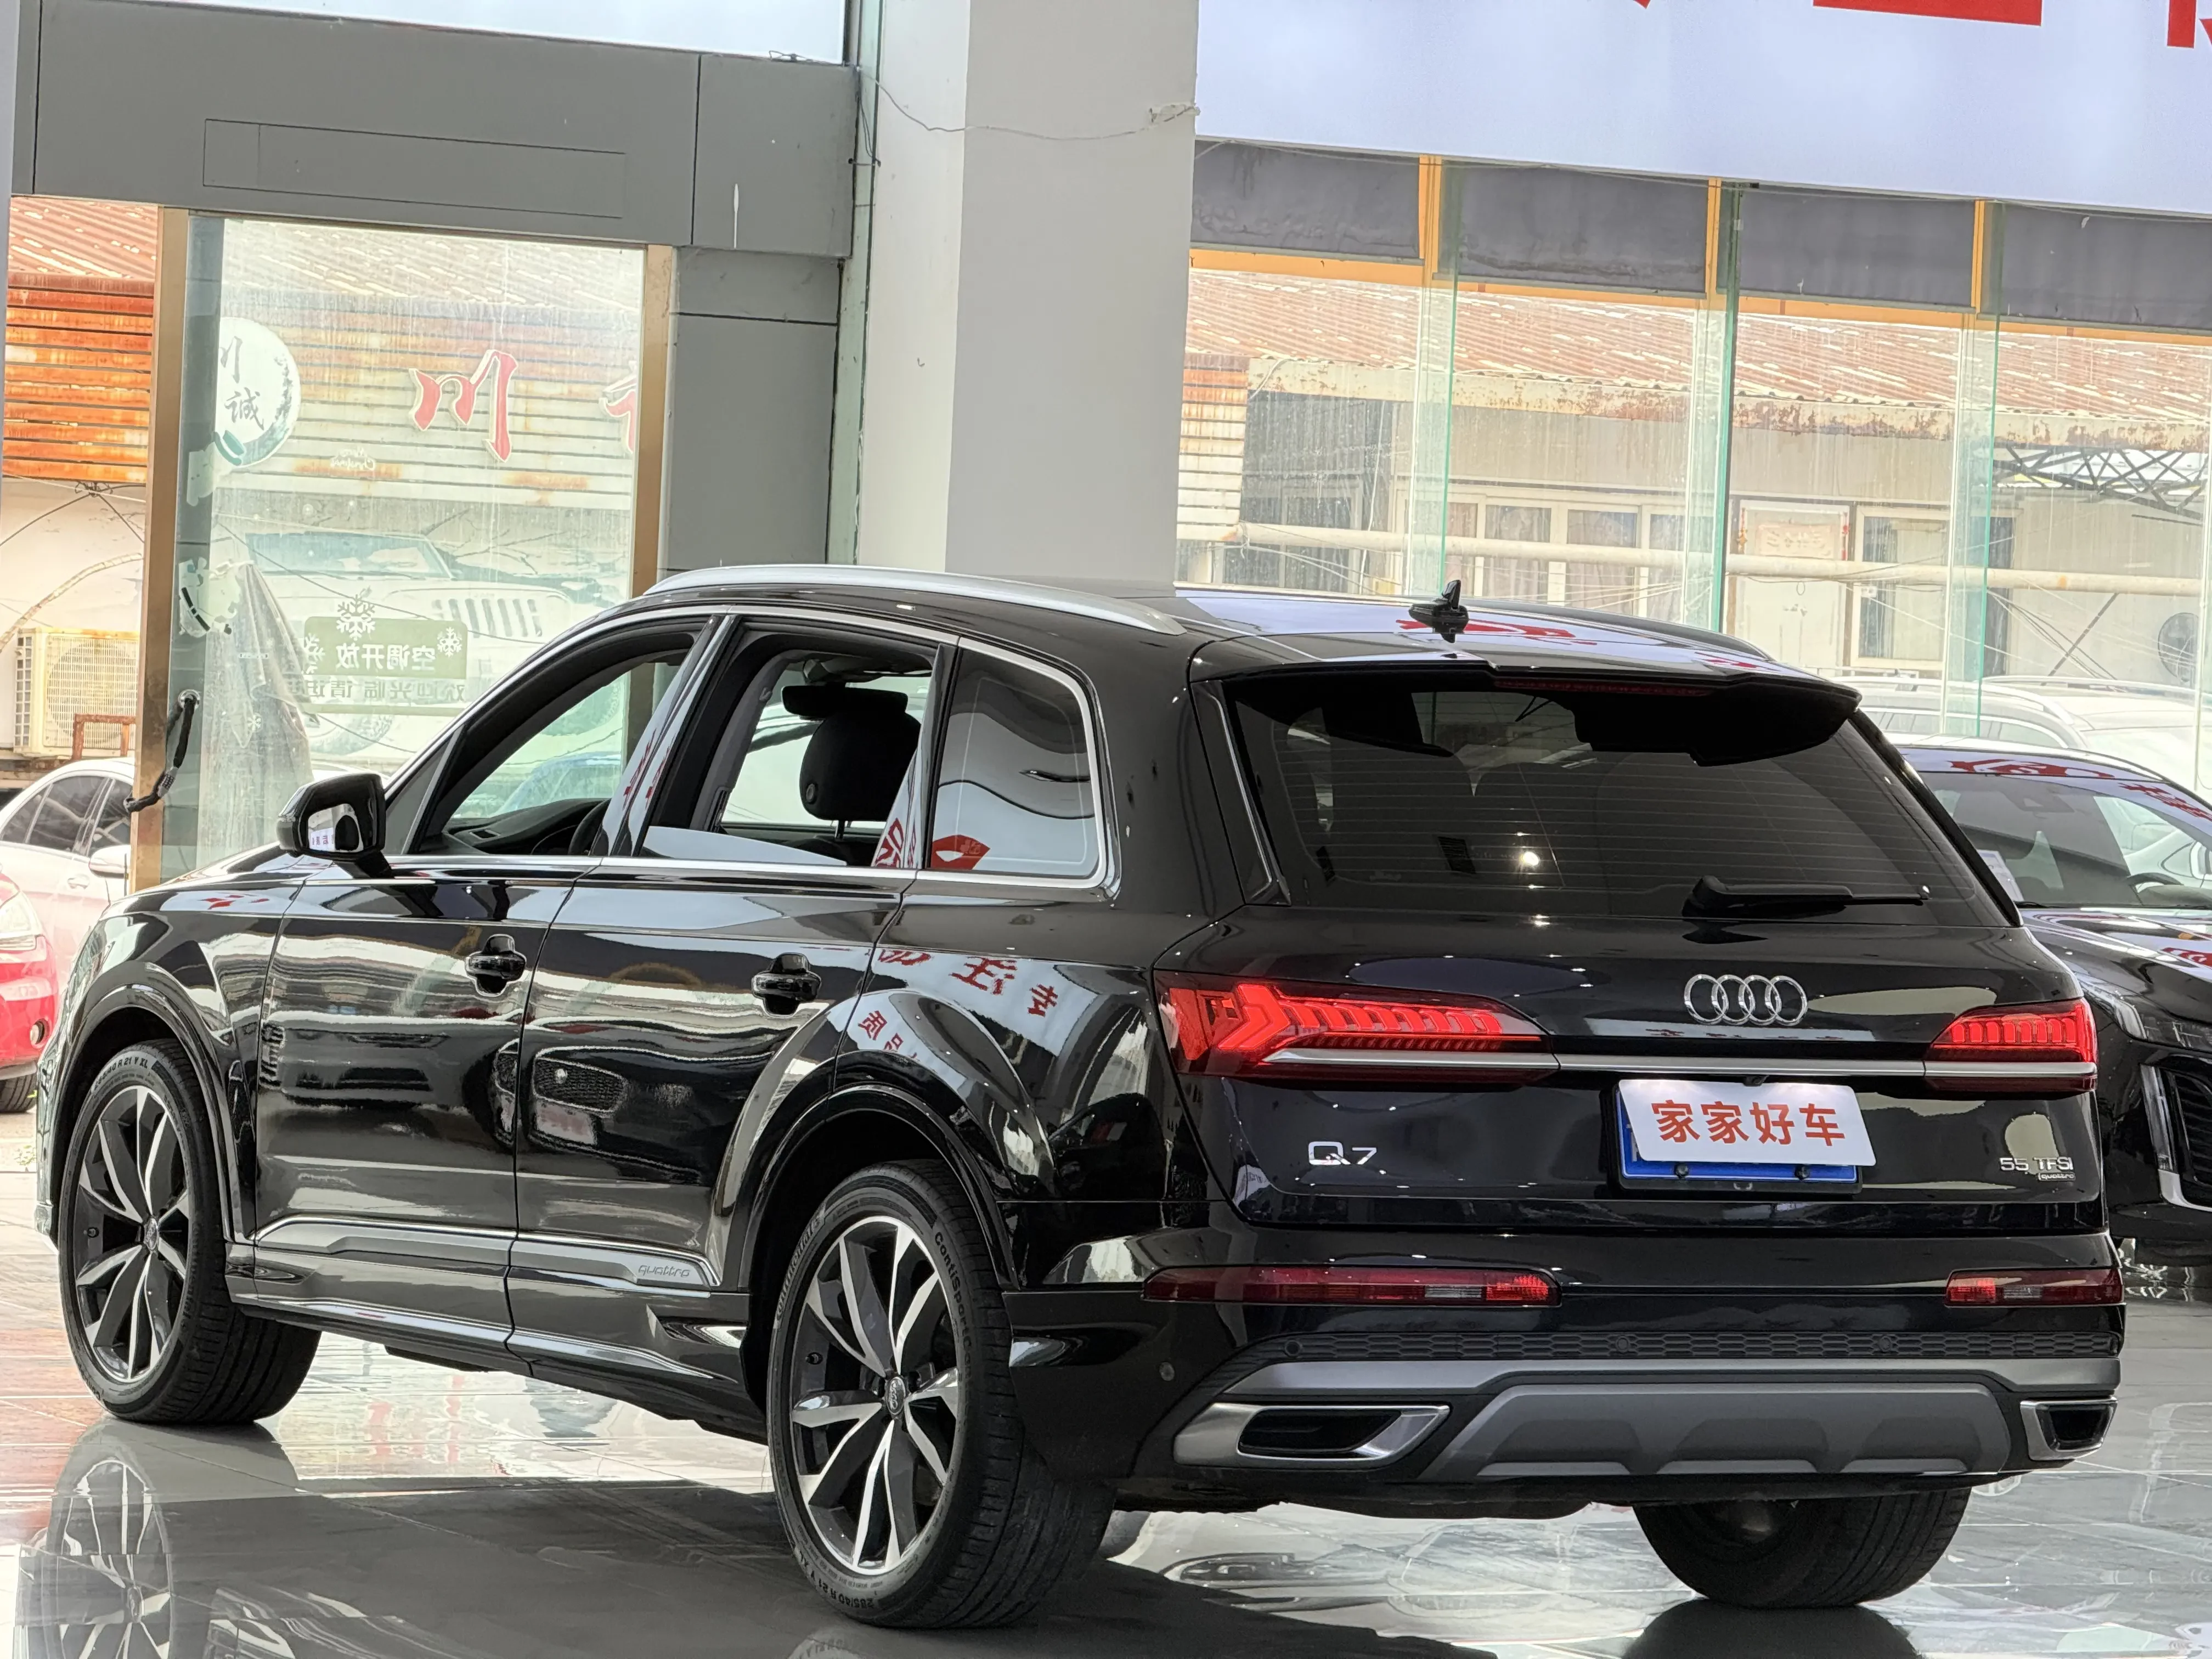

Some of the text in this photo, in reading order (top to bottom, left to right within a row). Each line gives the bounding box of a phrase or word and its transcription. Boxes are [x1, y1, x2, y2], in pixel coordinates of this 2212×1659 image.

[1651, 1099, 1846, 1147] 家家好车
[1308, 1141, 1377, 1165] Q7
[2000, 1156, 2074, 1171] 55 TFSI
[638, 1265, 691, 1278] quattro
